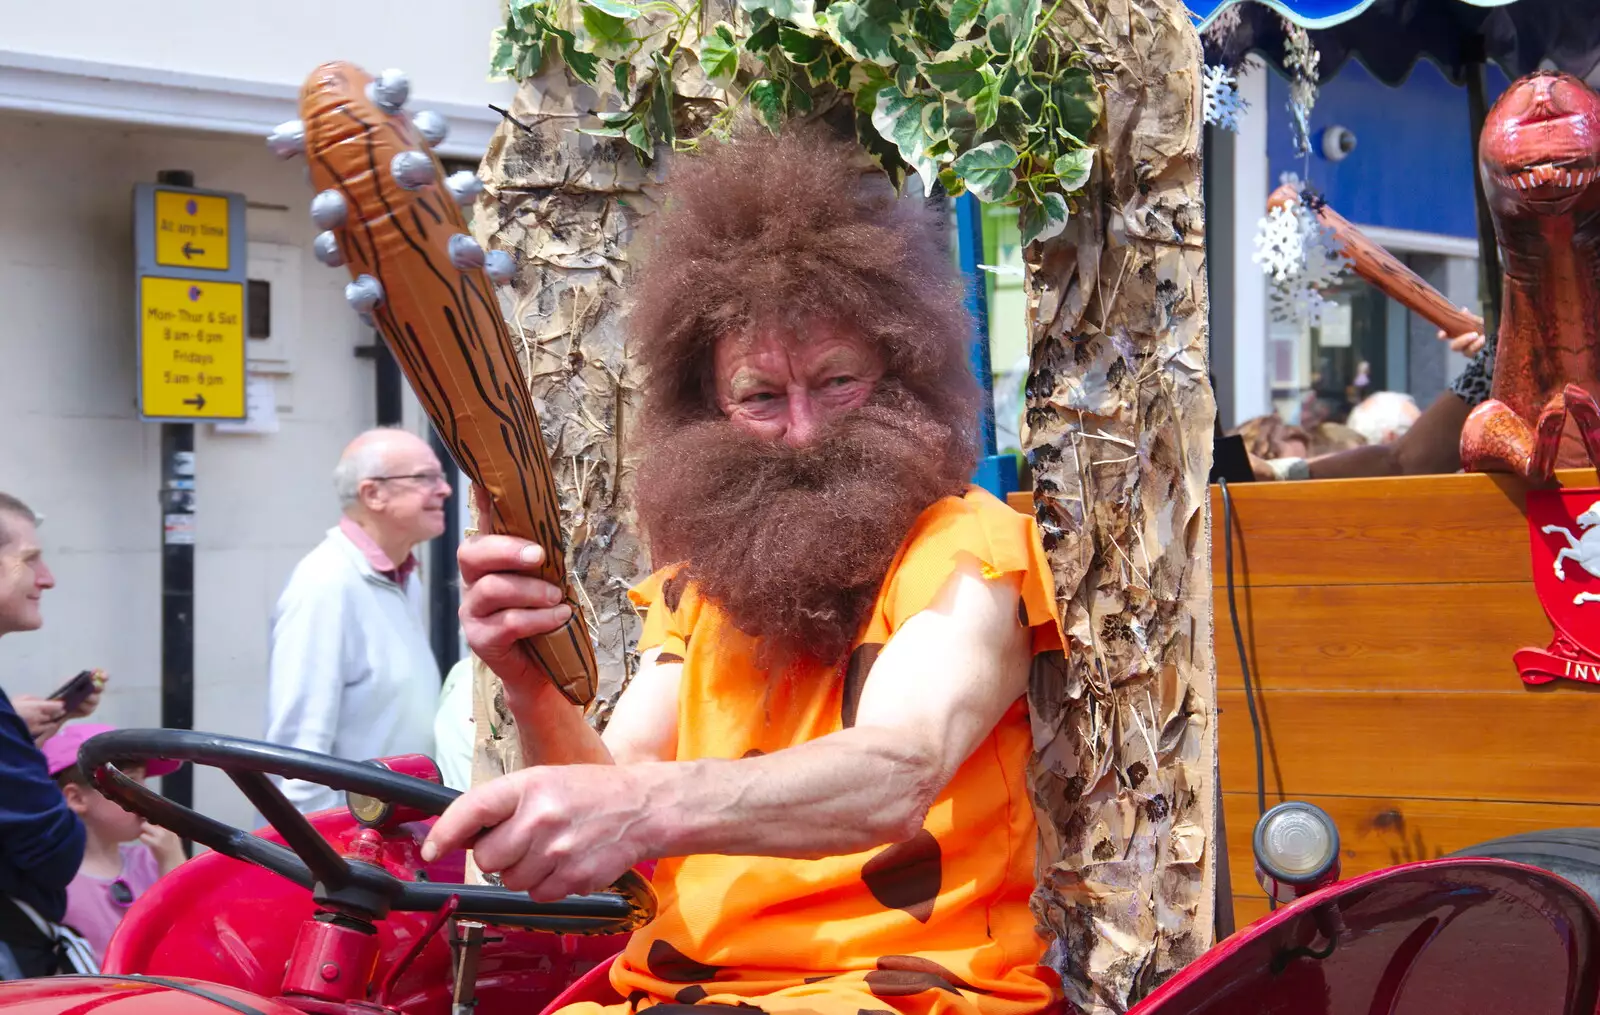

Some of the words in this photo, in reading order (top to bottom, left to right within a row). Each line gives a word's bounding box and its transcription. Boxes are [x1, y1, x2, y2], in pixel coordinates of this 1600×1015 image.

[161, 218, 174, 232] At
[178, 223, 197, 236] any
[200, 224, 224, 236] time
[218, 311, 238, 325] Sat
[173, 349, 214, 366] Fridays
